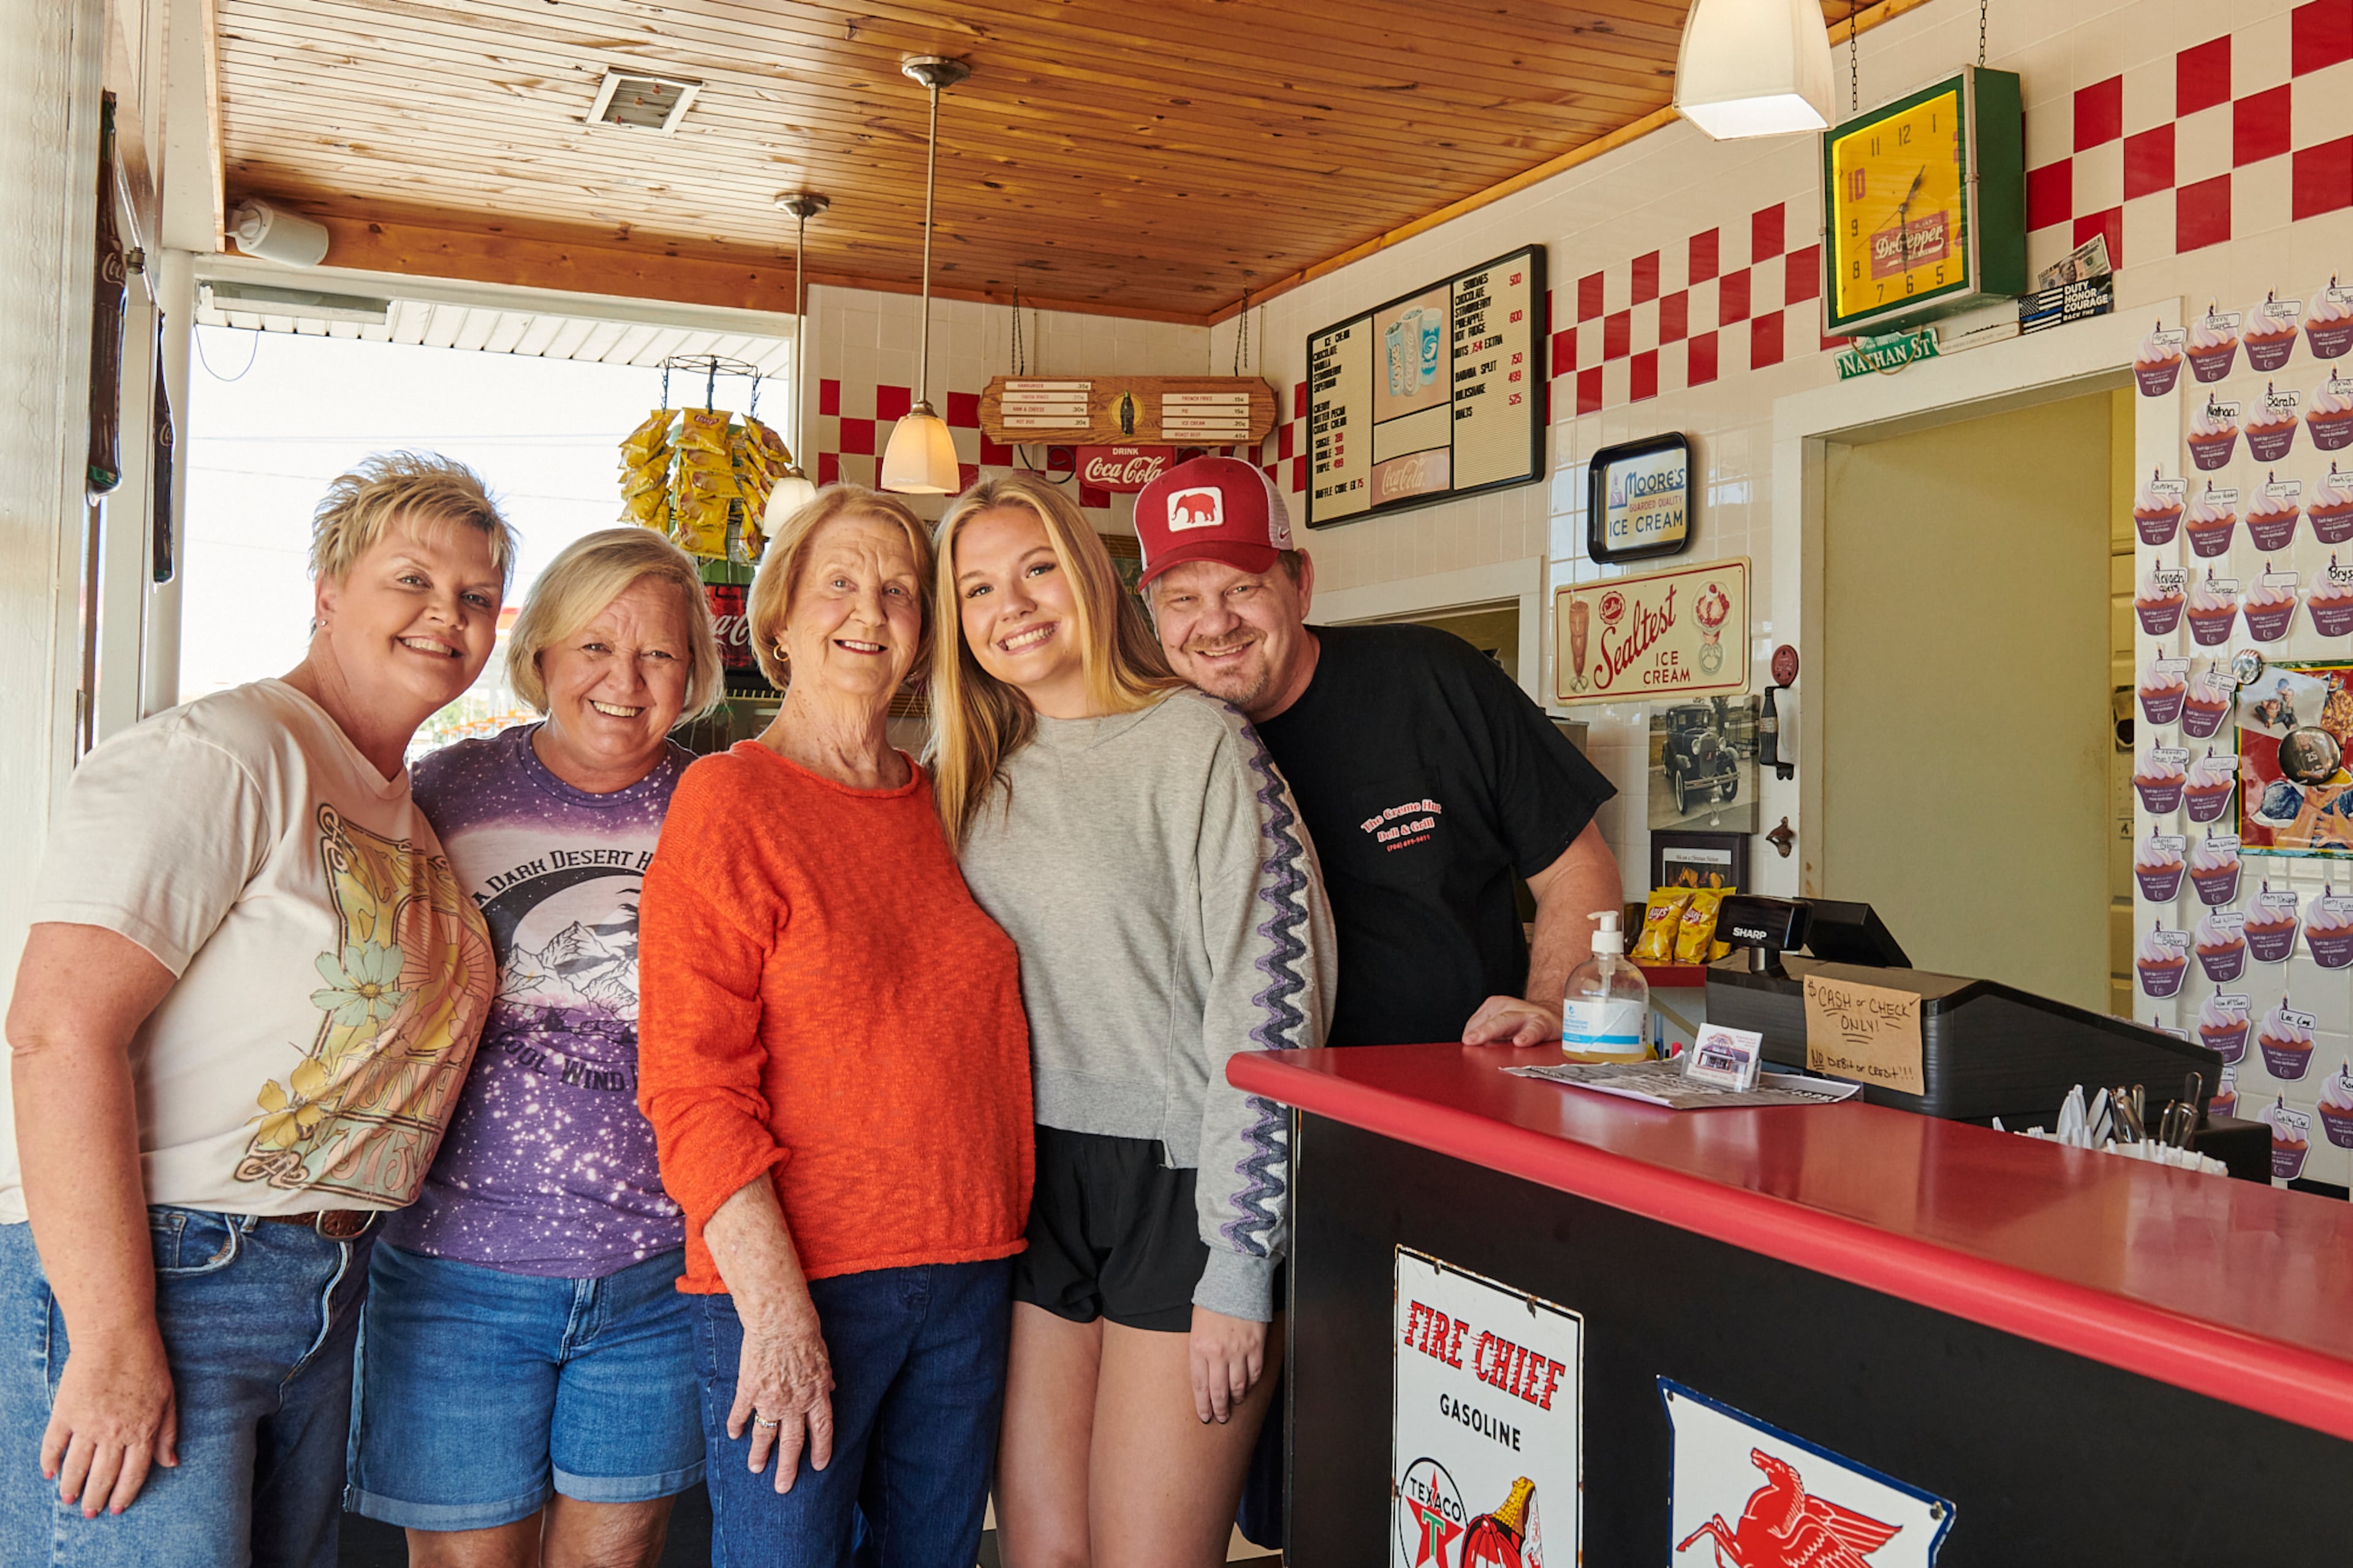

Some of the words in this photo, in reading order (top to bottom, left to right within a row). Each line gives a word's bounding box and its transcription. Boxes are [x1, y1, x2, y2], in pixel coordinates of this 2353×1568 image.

[1899, 124, 1911, 146] 12
[1848, 167, 1866, 203] 10
[1851, 218, 1858, 237] 9
[1852, 260, 1860, 279] 8
[1936, 265, 1944, 285] 5
[1877, 283, 1884, 303] 7
[1906, 275, 1914, 294] 6
[2063, 294, 2109, 313] COURAGE
[2063, 311, 2081, 321] BACK
[1843, 344, 1908, 376] NATHAN
[1911, 337, 1931, 358] ST
[1509, 392, 1521, 406] 525
[2267, 394, 2296, 406] Sarah
[2207, 404, 2235, 417] Nathan
[1629, 500, 1656, 513] GUARDED
[1658, 494, 1683, 509] QUALITY
[1609, 519, 1627, 537] ICE
[1635, 509, 1683, 532] CREAM
[1593, 583, 1677, 690] Sealtest
[1656, 650, 1678, 667] ICE
[1643, 667, 1691, 684] CREAM
[2305, 751, 2319, 761] 25
[1360, 815, 1384, 833] The
[1383, 801, 1422, 820] Creme
[1377, 827, 1400, 843] Deli
[1400, 824, 1411, 836] &
[1410, 817, 1435, 832] Grill
[472, 891, 491, 906] A
[486, 858, 547, 894] DARK
[548, 849, 634, 869] DESERT
[1732, 926, 1767, 941] SHARP
[1818, 986, 1852, 1009] CASH
[1869, 998, 1911, 1018] CHECK
[1841, 1015, 1880, 1033] ONLY!
[496, 1030, 550, 1076] COOL
[559, 1057, 625, 1092] WIND
[1811, 1049, 1824, 1064] NO
[1401, 1300, 1469, 1370] FIRE
[1471, 1330, 1566, 1412] CHIEF
[1439, 1393, 1521, 1453] GASOLINE
[1411, 1477, 1462, 1523] TEXACO
[1421, 1509, 1446, 1558] T
